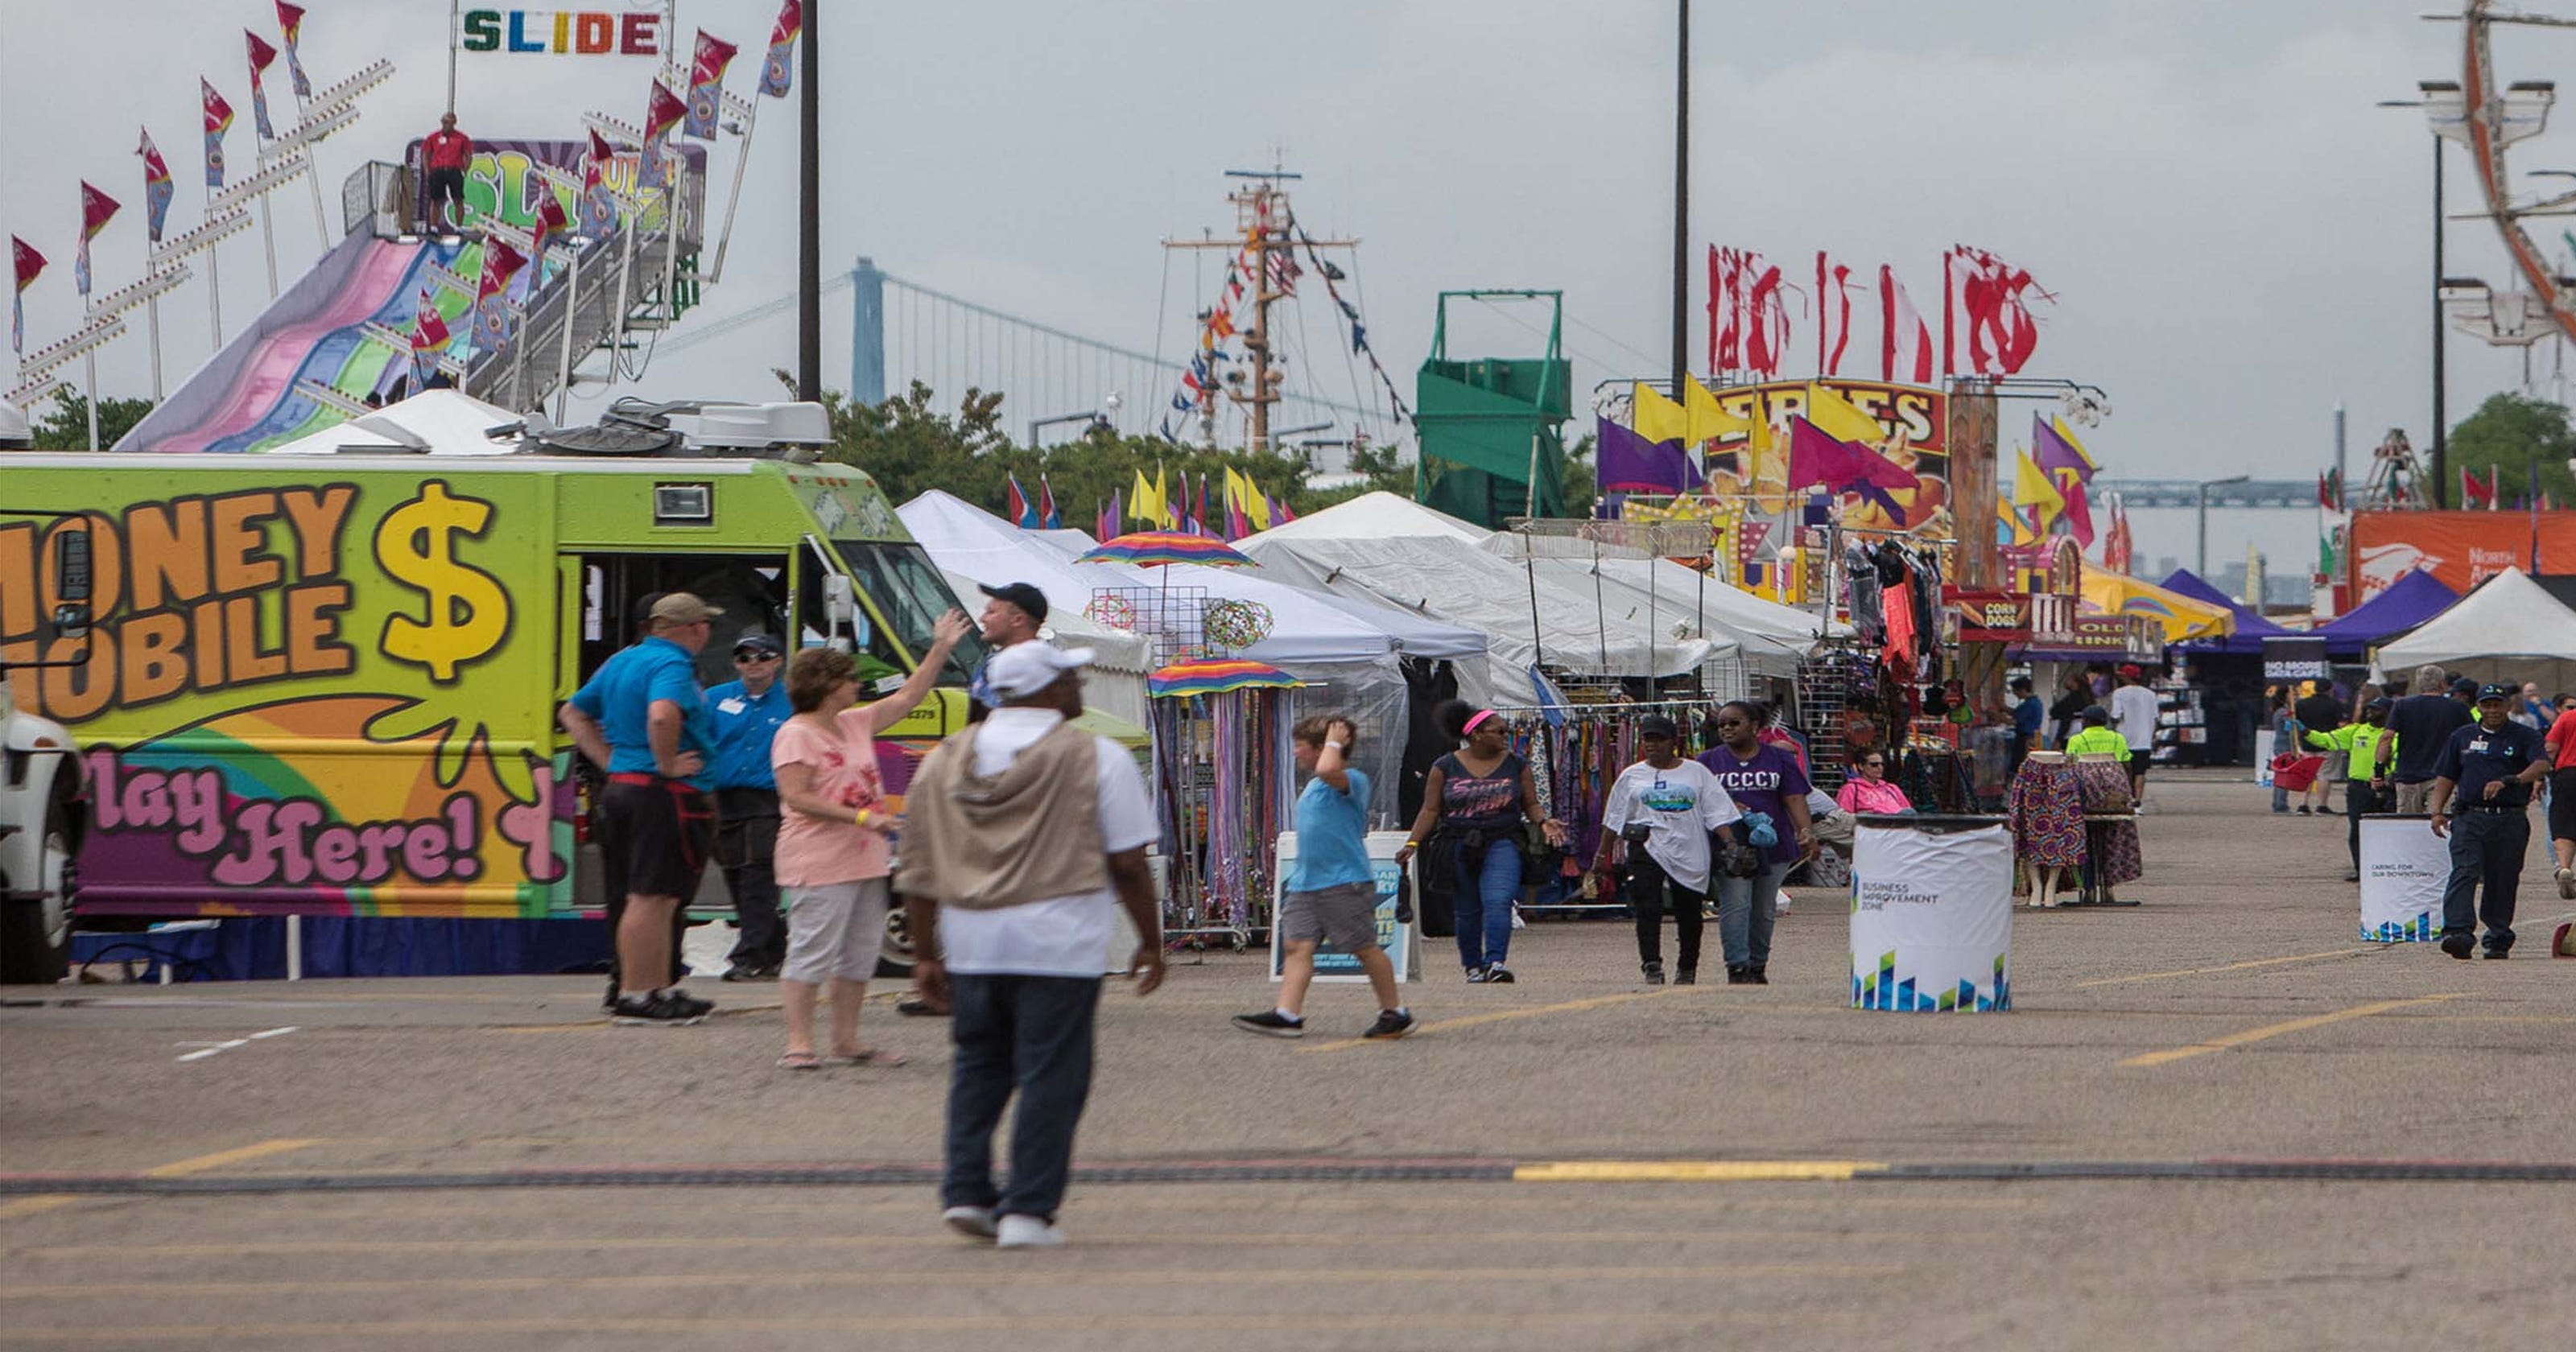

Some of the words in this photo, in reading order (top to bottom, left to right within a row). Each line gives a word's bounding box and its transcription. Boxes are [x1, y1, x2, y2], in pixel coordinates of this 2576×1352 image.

[464, 10, 661, 56] SLIDE
[1985, 604, 2017, 615] CORN
[1985, 615, 2017, 627] DOGS
[82, 744, 227, 855] lay
[211, 792, 483, 884] Here!
[1862, 882, 1909, 892] BUSINESS
[1862, 894, 1938, 905] IMPROVEMENT
[1861, 901, 1885, 911] ZONE
